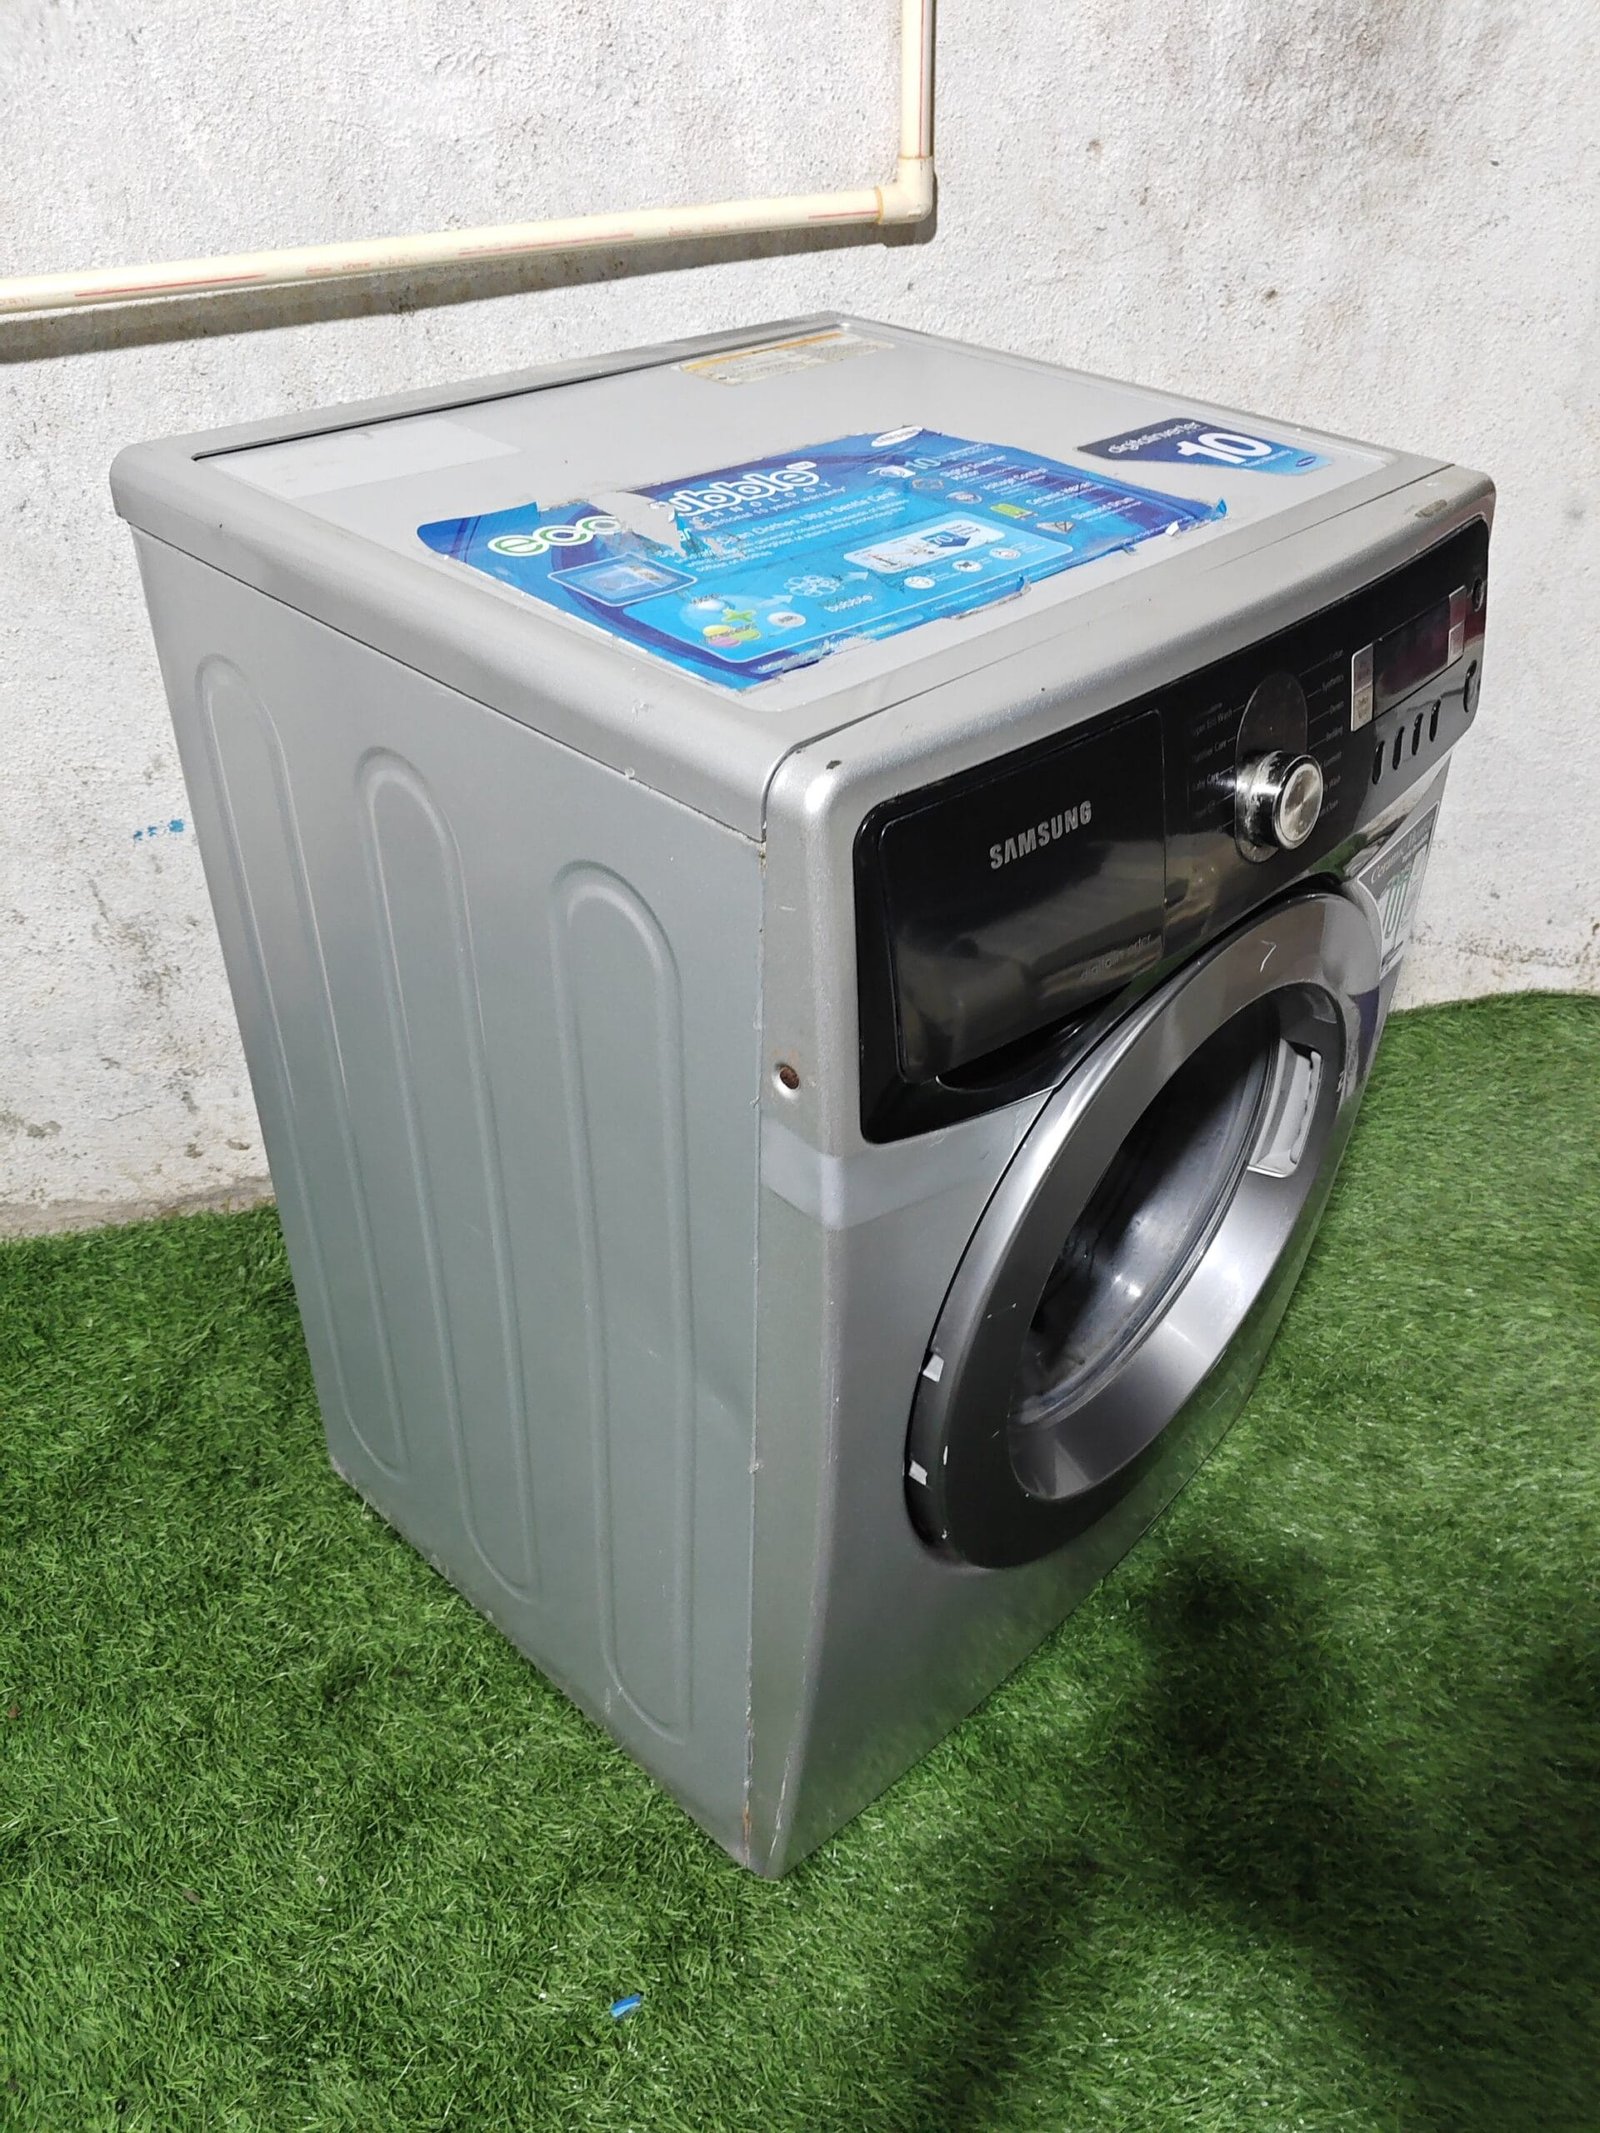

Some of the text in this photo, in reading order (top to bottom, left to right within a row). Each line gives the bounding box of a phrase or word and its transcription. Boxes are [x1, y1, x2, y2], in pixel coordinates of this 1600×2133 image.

[905, 457, 942, 469] 10
[1177, 432, 1273, 464] 10
[988, 799, 1093, 871] SAMSUNG
